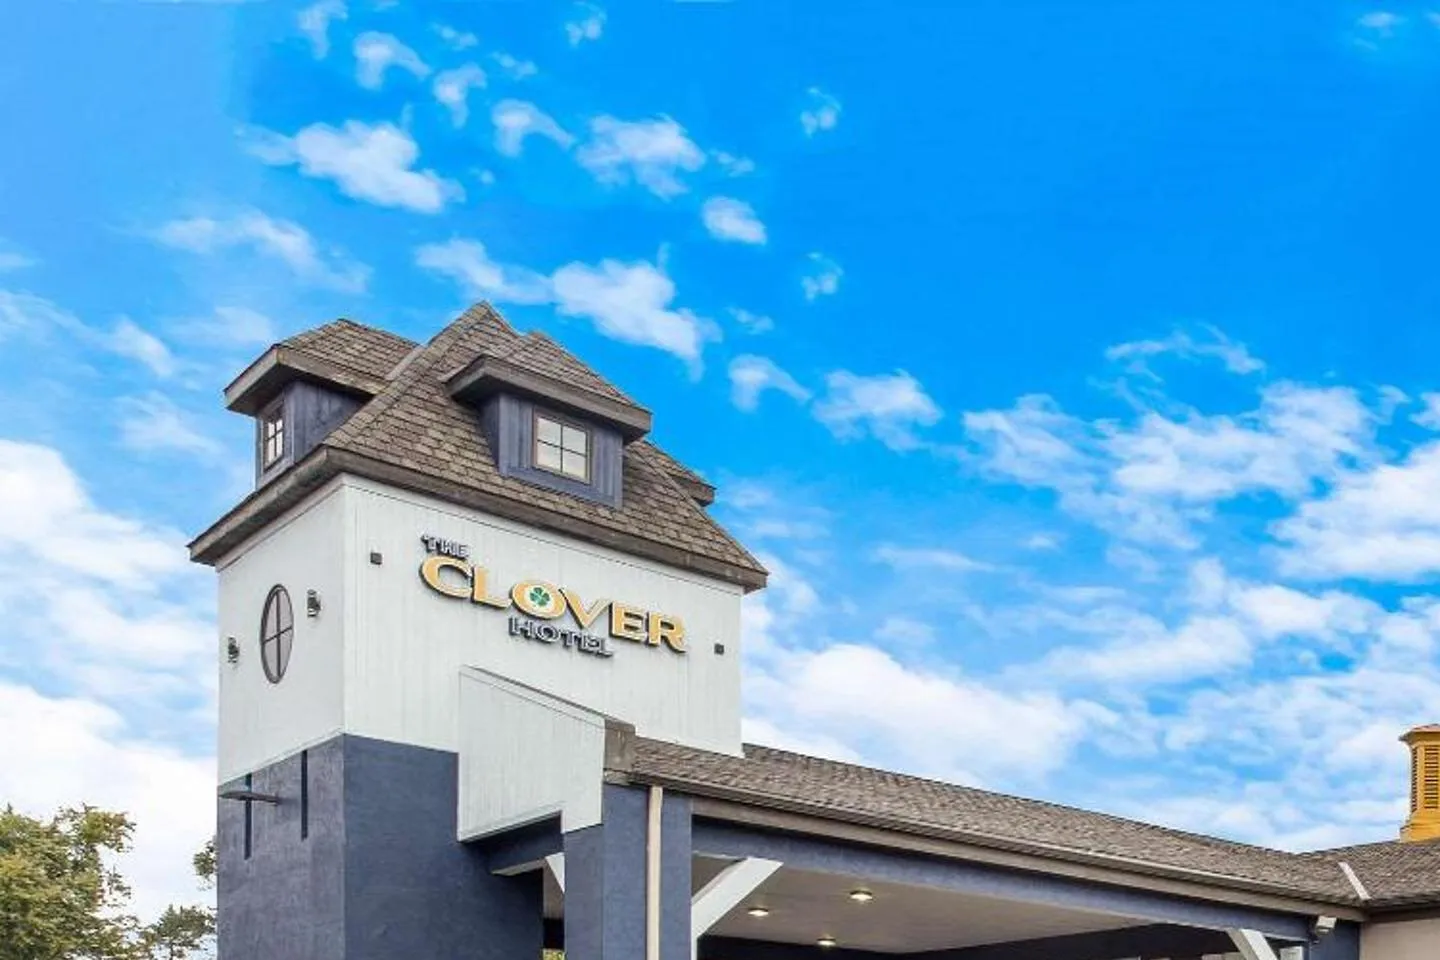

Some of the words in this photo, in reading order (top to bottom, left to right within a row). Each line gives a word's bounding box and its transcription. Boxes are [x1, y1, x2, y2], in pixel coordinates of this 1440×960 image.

[421, 534, 470, 559] THE
[420, 555, 686, 653] CLOVER
[508, 617, 613, 657] HOTEL
